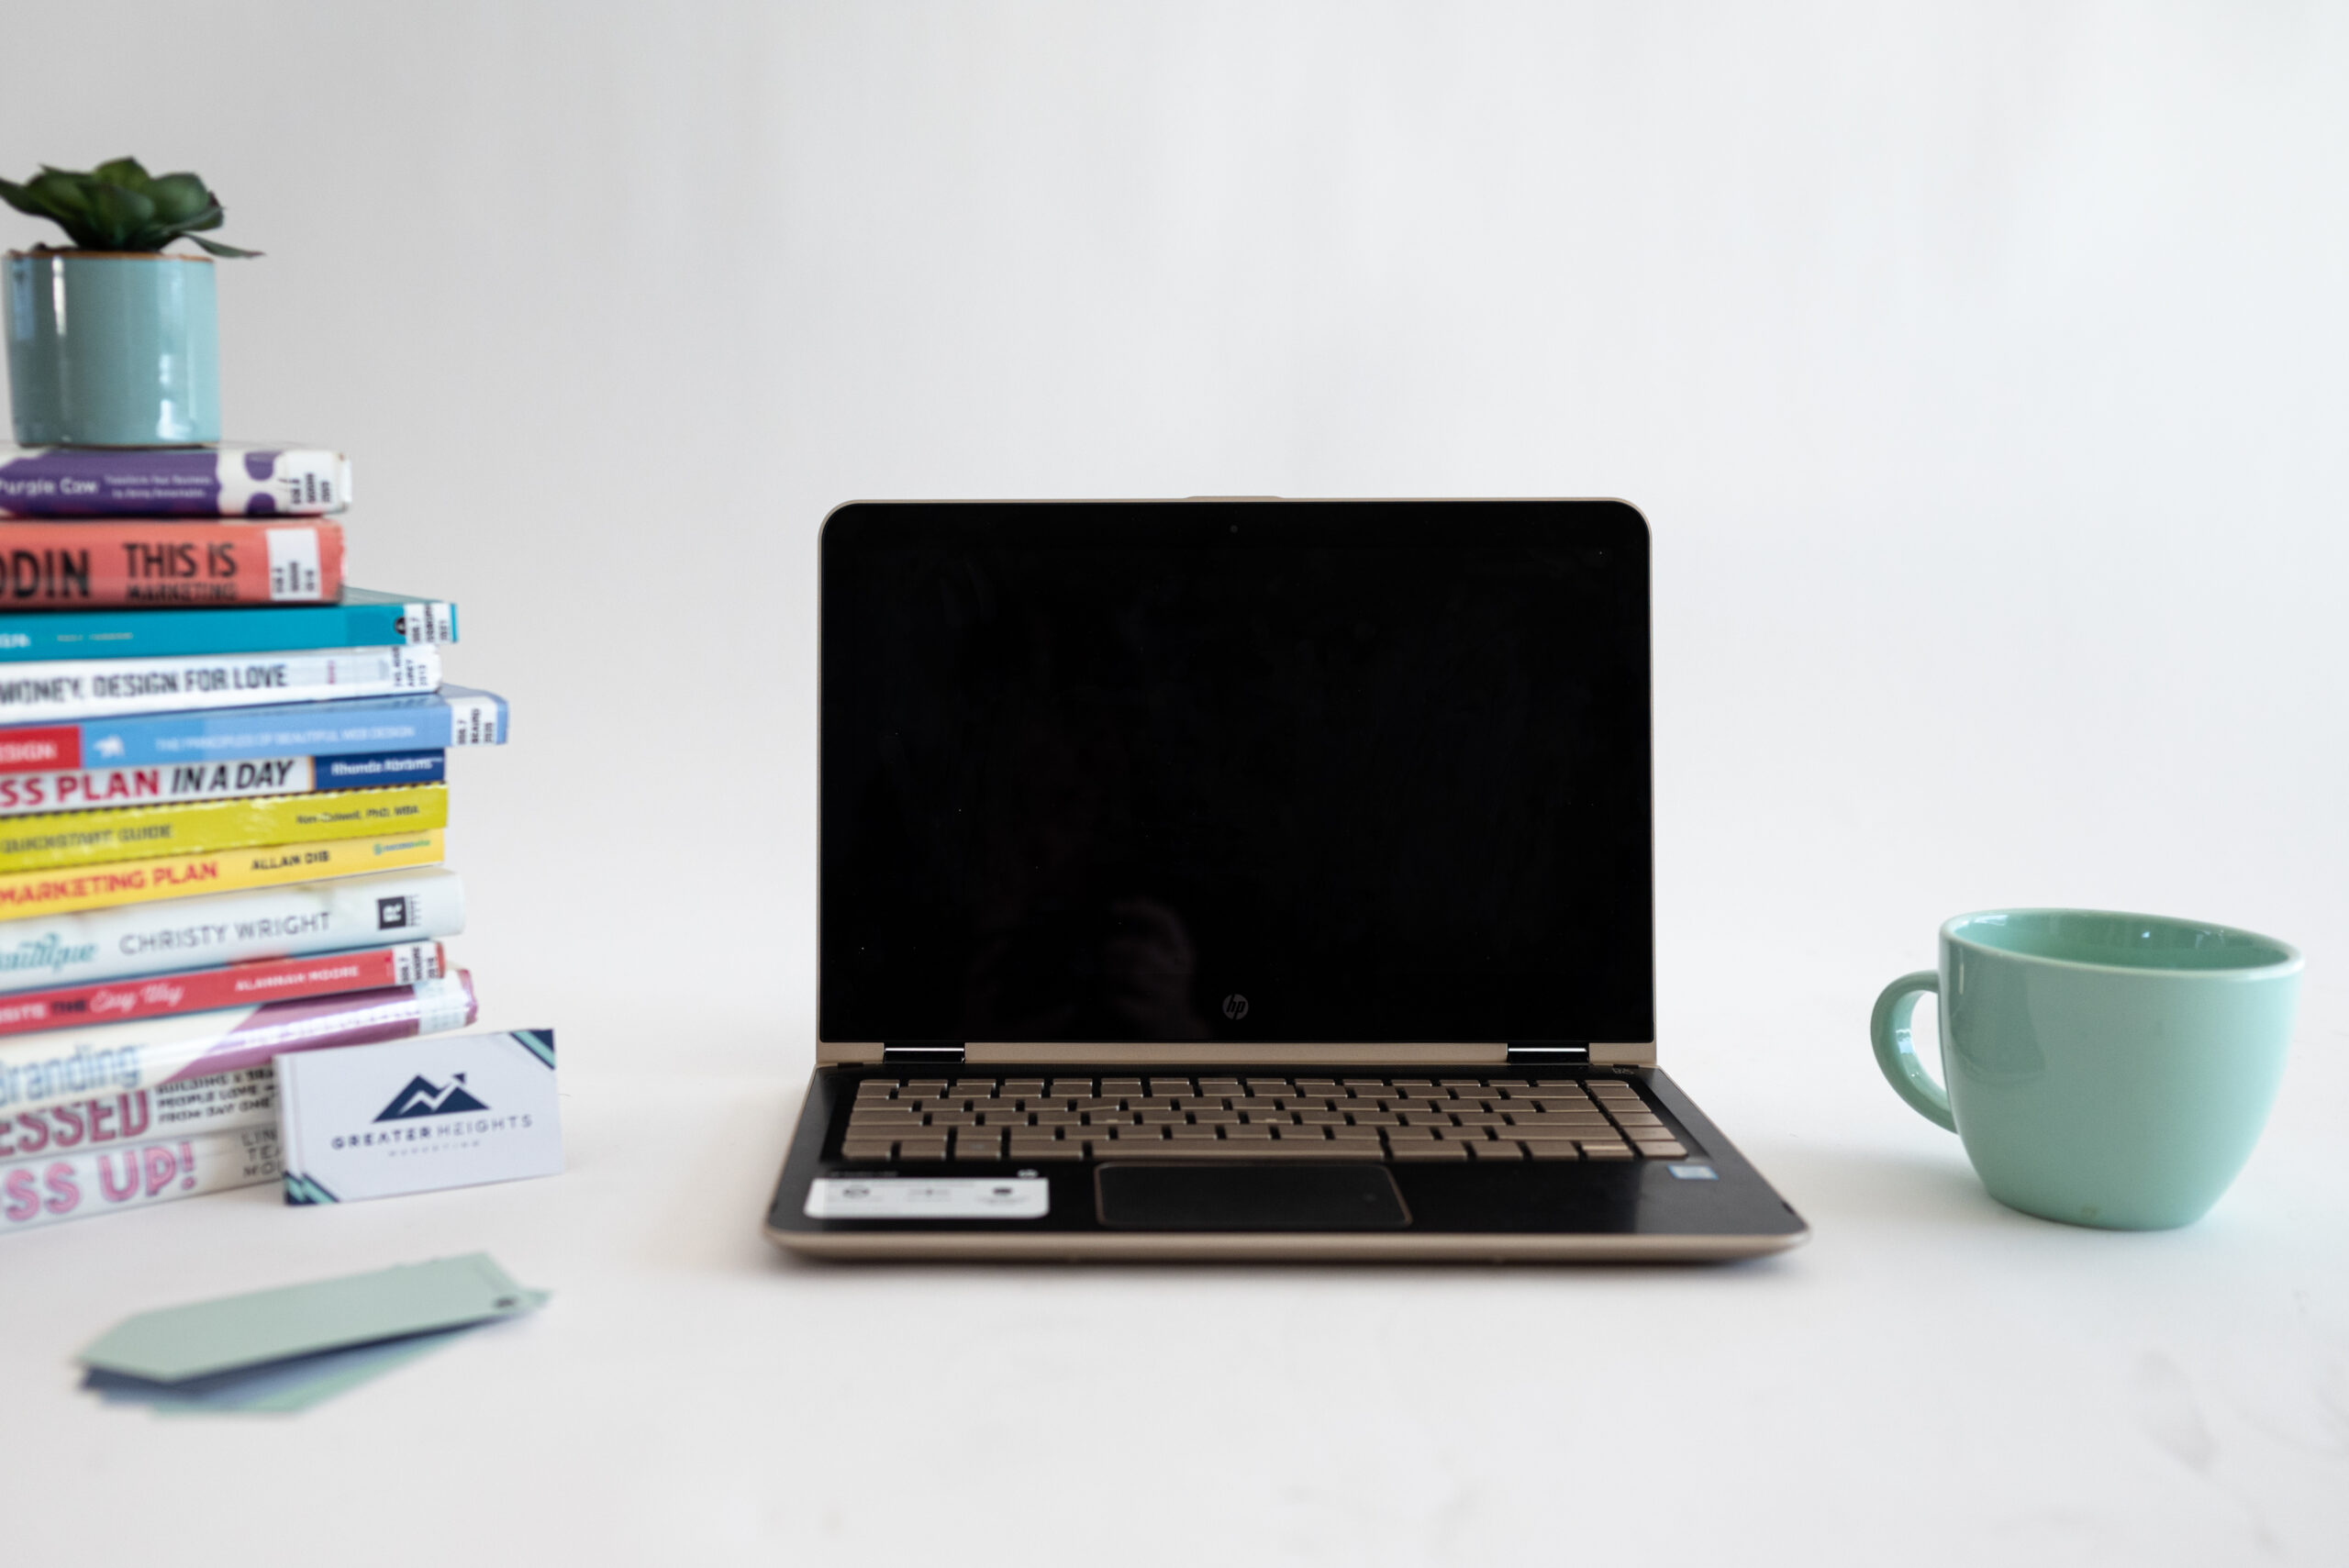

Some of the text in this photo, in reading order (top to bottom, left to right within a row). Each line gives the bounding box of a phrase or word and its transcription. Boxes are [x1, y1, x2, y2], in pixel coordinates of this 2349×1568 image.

[123, 541, 238, 579] THIS IS
[127, 580, 237, 602] MARKETING
[93, 672, 178, 699] DESIGN
[184, 667, 230, 693] FOR
[233, 663, 288, 689] LOVE
[57, 769, 159, 803] PLAN
[171, 766, 205, 795] IN
[207, 763, 232, 792] A
[235, 759, 295, 790] DAY
[117, 824, 173, 842] GUIDE
[250, 850, 329, 871] ALLAN DIB
[0, 861, 218, 905] MARKETING PLAN
[383, 903, 403, 923] R
[118, 912, 330, 956] CHRISTY WRIGHT
[307, 965, 360, 983] MOORE
[50, 998, 86, 1013] THE
[330, 1114, 533, 1151] GREATER HEIGHTS
[95, 1140, 196, 1204] UP!
